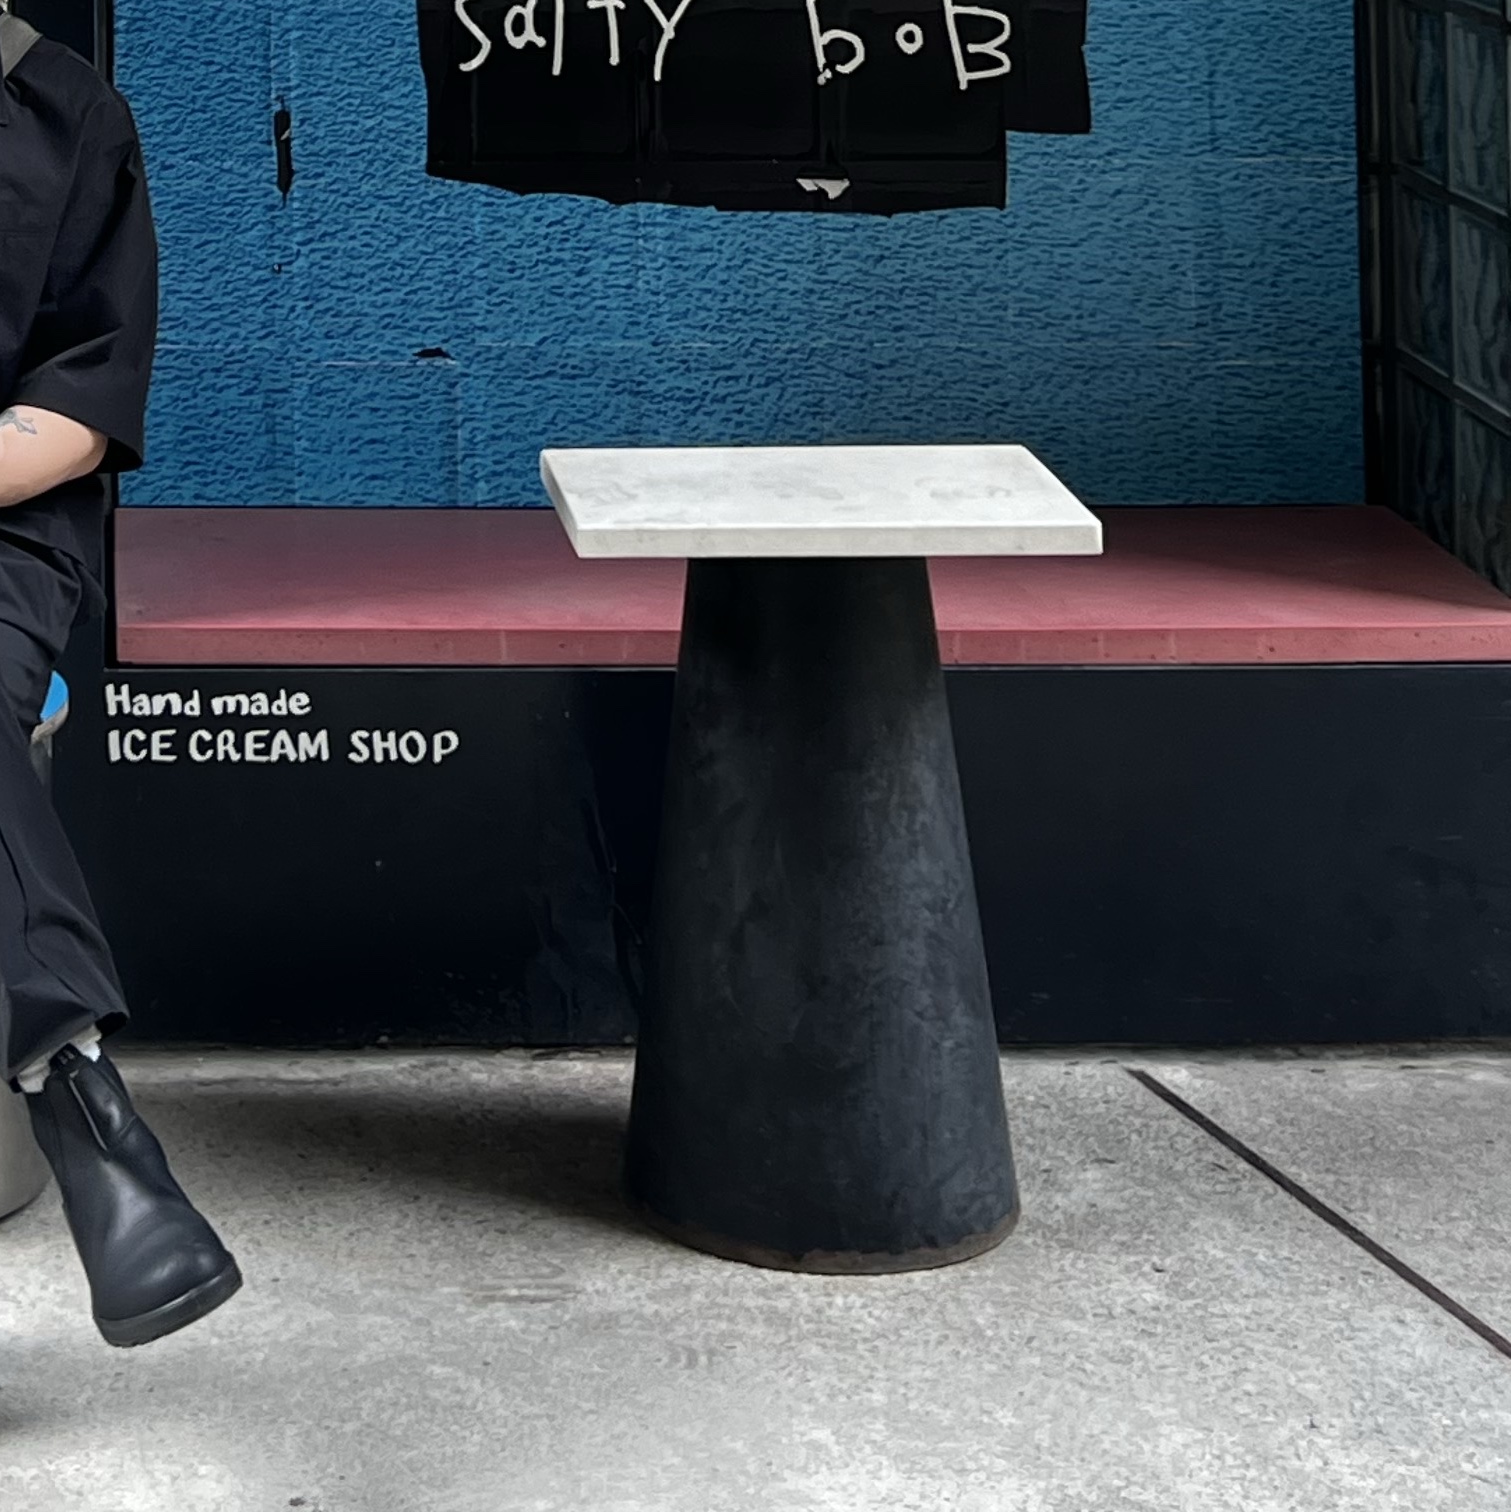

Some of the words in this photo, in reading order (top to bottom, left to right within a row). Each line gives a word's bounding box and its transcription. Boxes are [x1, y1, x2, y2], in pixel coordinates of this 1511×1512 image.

[104, 682, 202, 717] Hand
[210, 688, 313, 717] made
[107, 728, 179, 763] ICE
[187, 728, 331, 763] CREAM
[347, 728, 460, 764] SHOP
